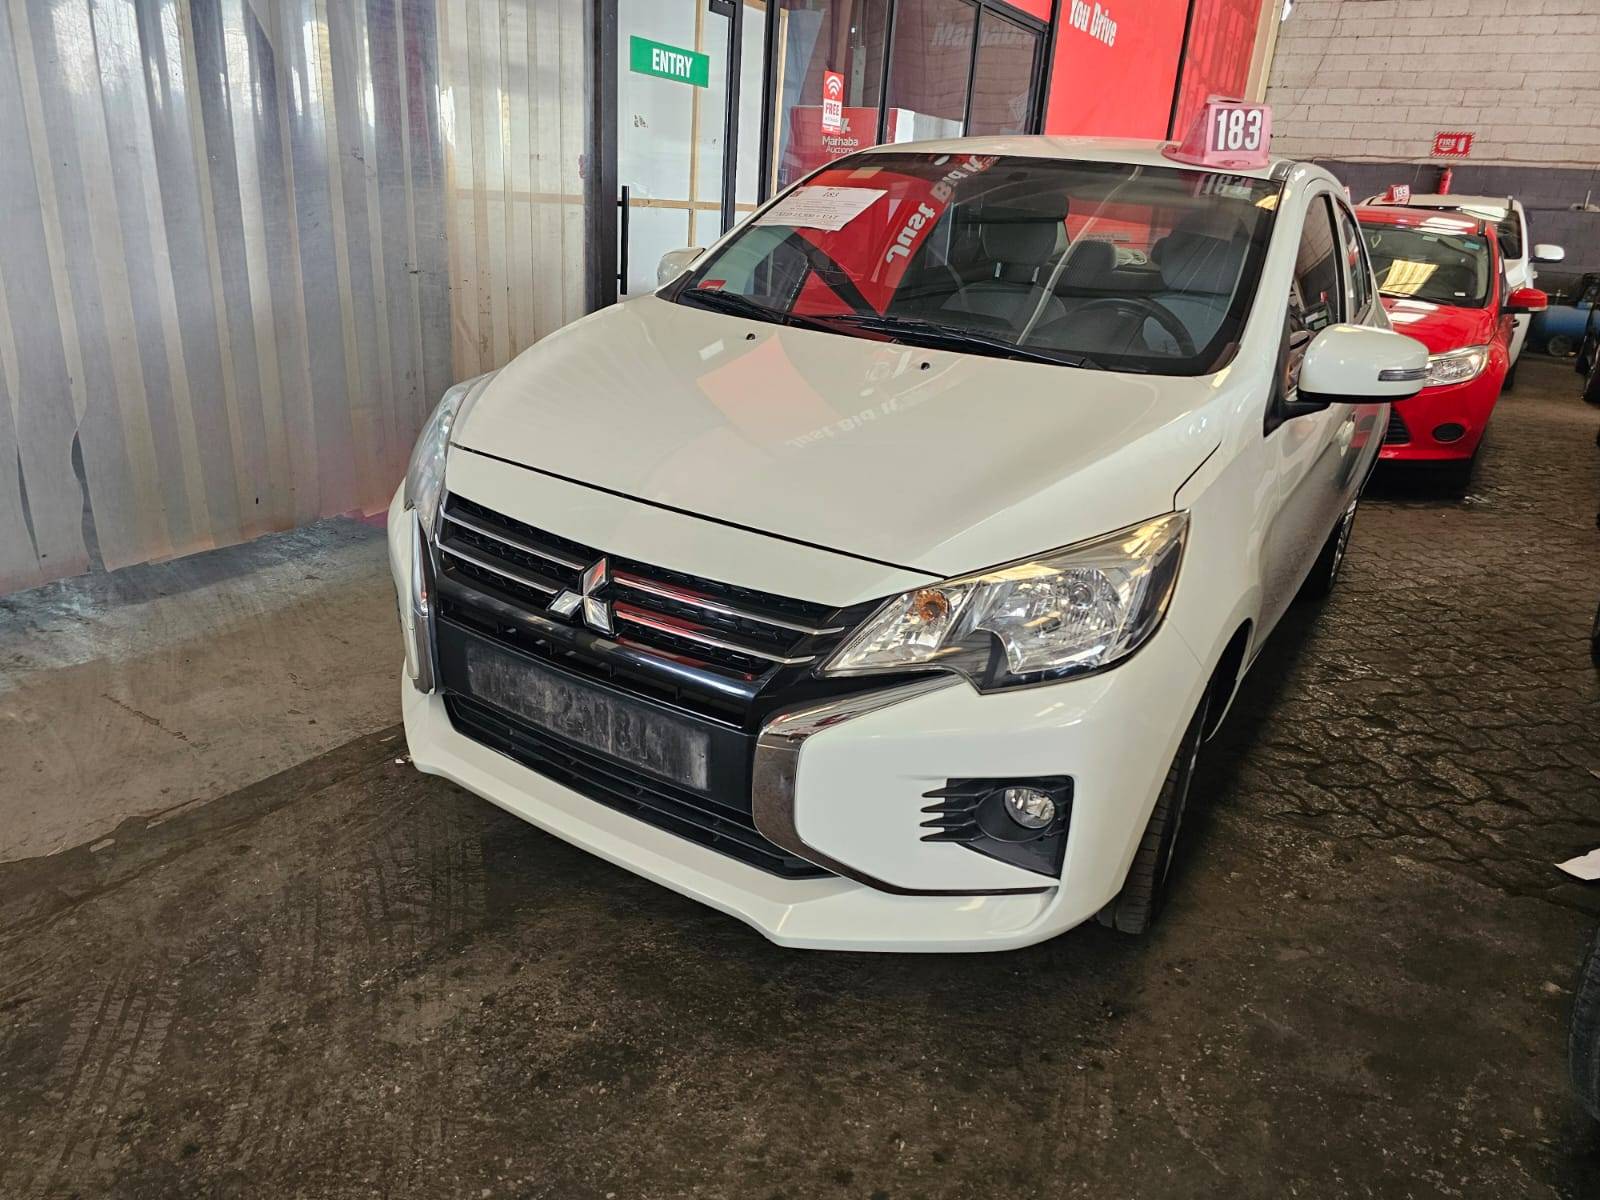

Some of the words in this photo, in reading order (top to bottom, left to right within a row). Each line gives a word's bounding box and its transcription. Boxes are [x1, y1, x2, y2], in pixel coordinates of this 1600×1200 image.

[1069, 0, 1091, 32] You
[1089, 2, 1117, 47] Drive
[652, 48, 693, 78] ENTRY
[825, 102, 840, 117] FREE
[822, 135, 859, 146] Marhaba
[1217, 109, 1262, 150] 183
